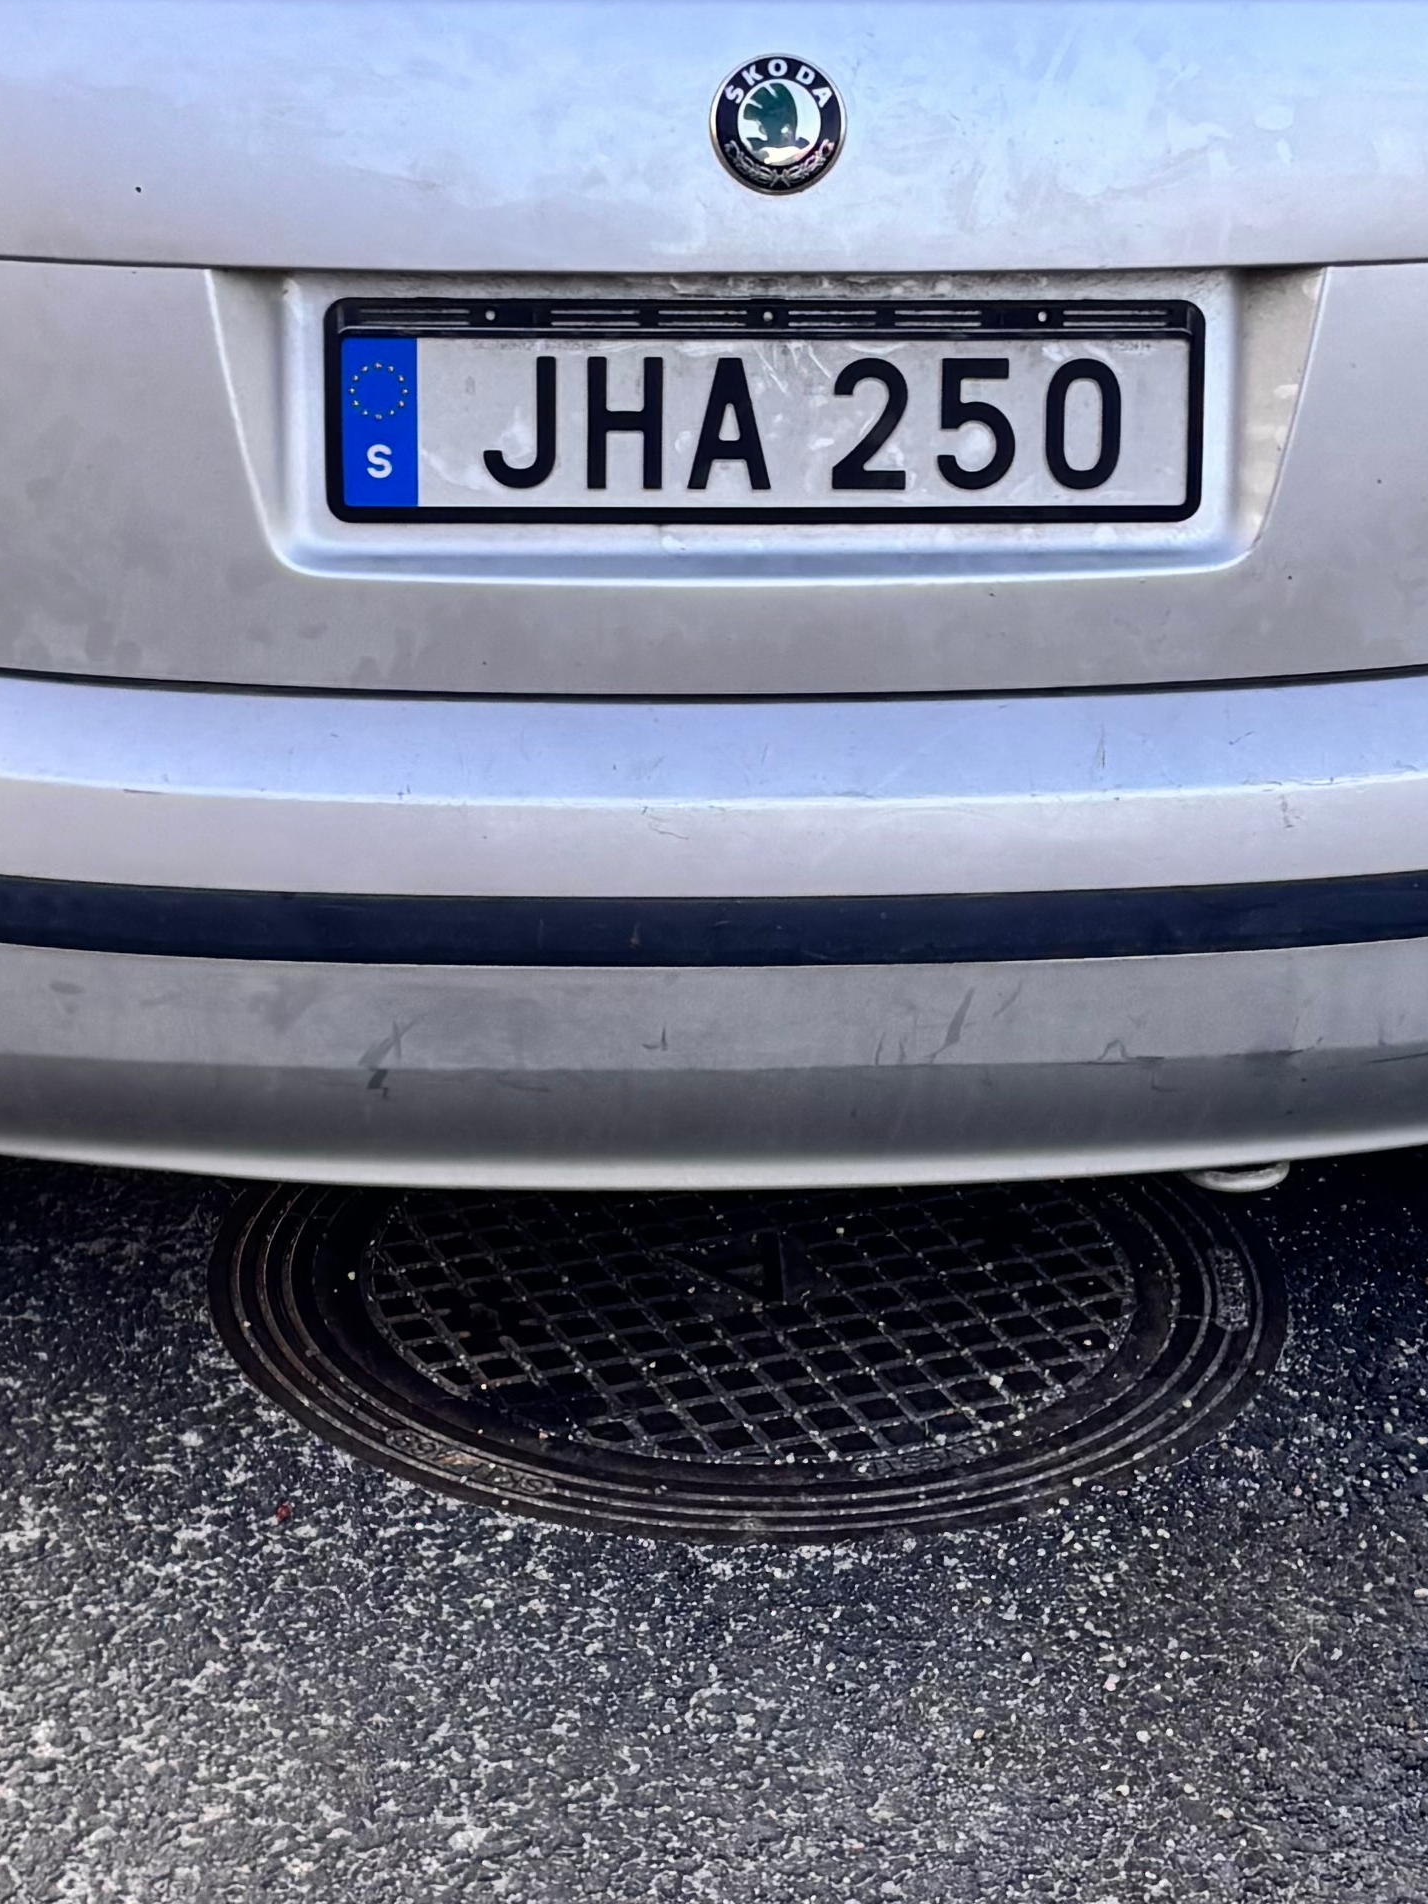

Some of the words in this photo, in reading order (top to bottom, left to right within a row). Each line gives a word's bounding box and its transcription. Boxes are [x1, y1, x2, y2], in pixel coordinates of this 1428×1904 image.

[365, 443, 394, 481] S
[482, 355, 772, 491] JHA
[830, 356, 1123, 492] 250
